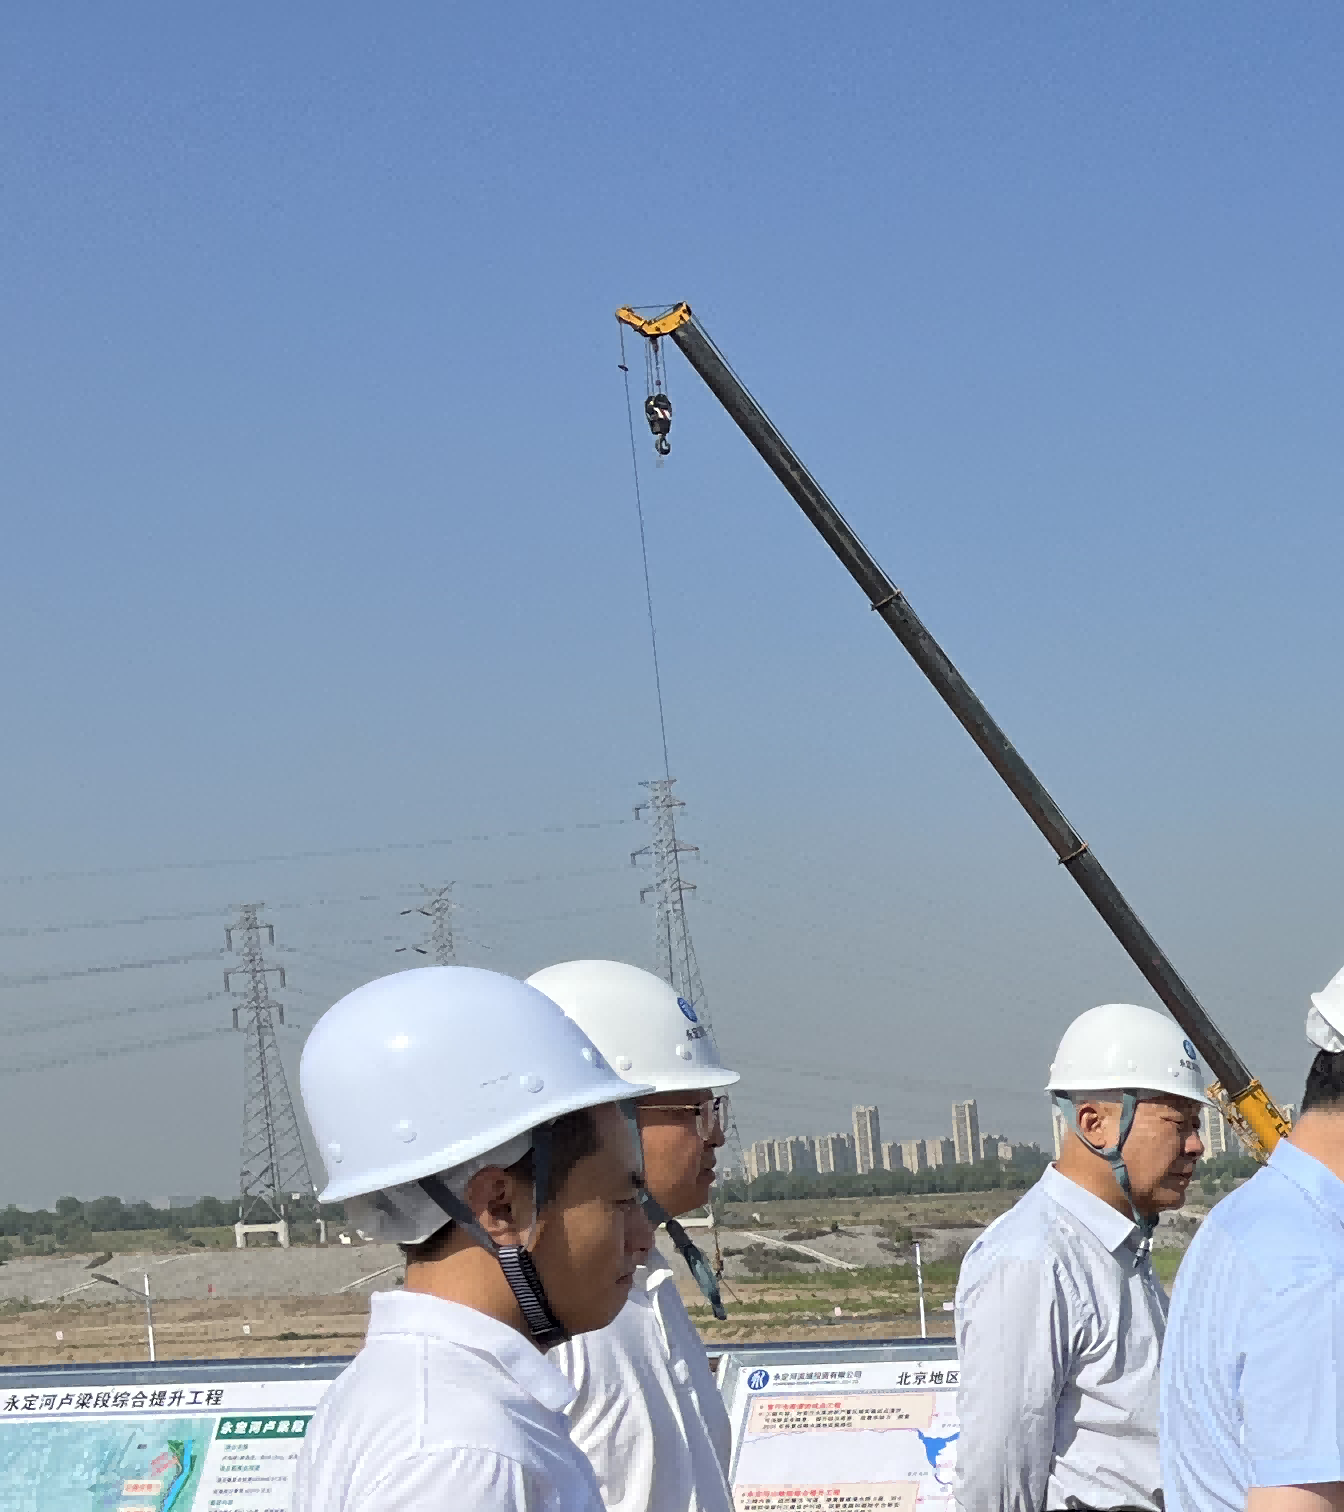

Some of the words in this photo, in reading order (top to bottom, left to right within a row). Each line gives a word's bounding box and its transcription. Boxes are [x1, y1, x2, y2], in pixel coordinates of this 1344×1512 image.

[896, 1371, 960, 1385] 北京地区
[3, 1389, 224, 1411] 永定河卢梁段综合提升工程
